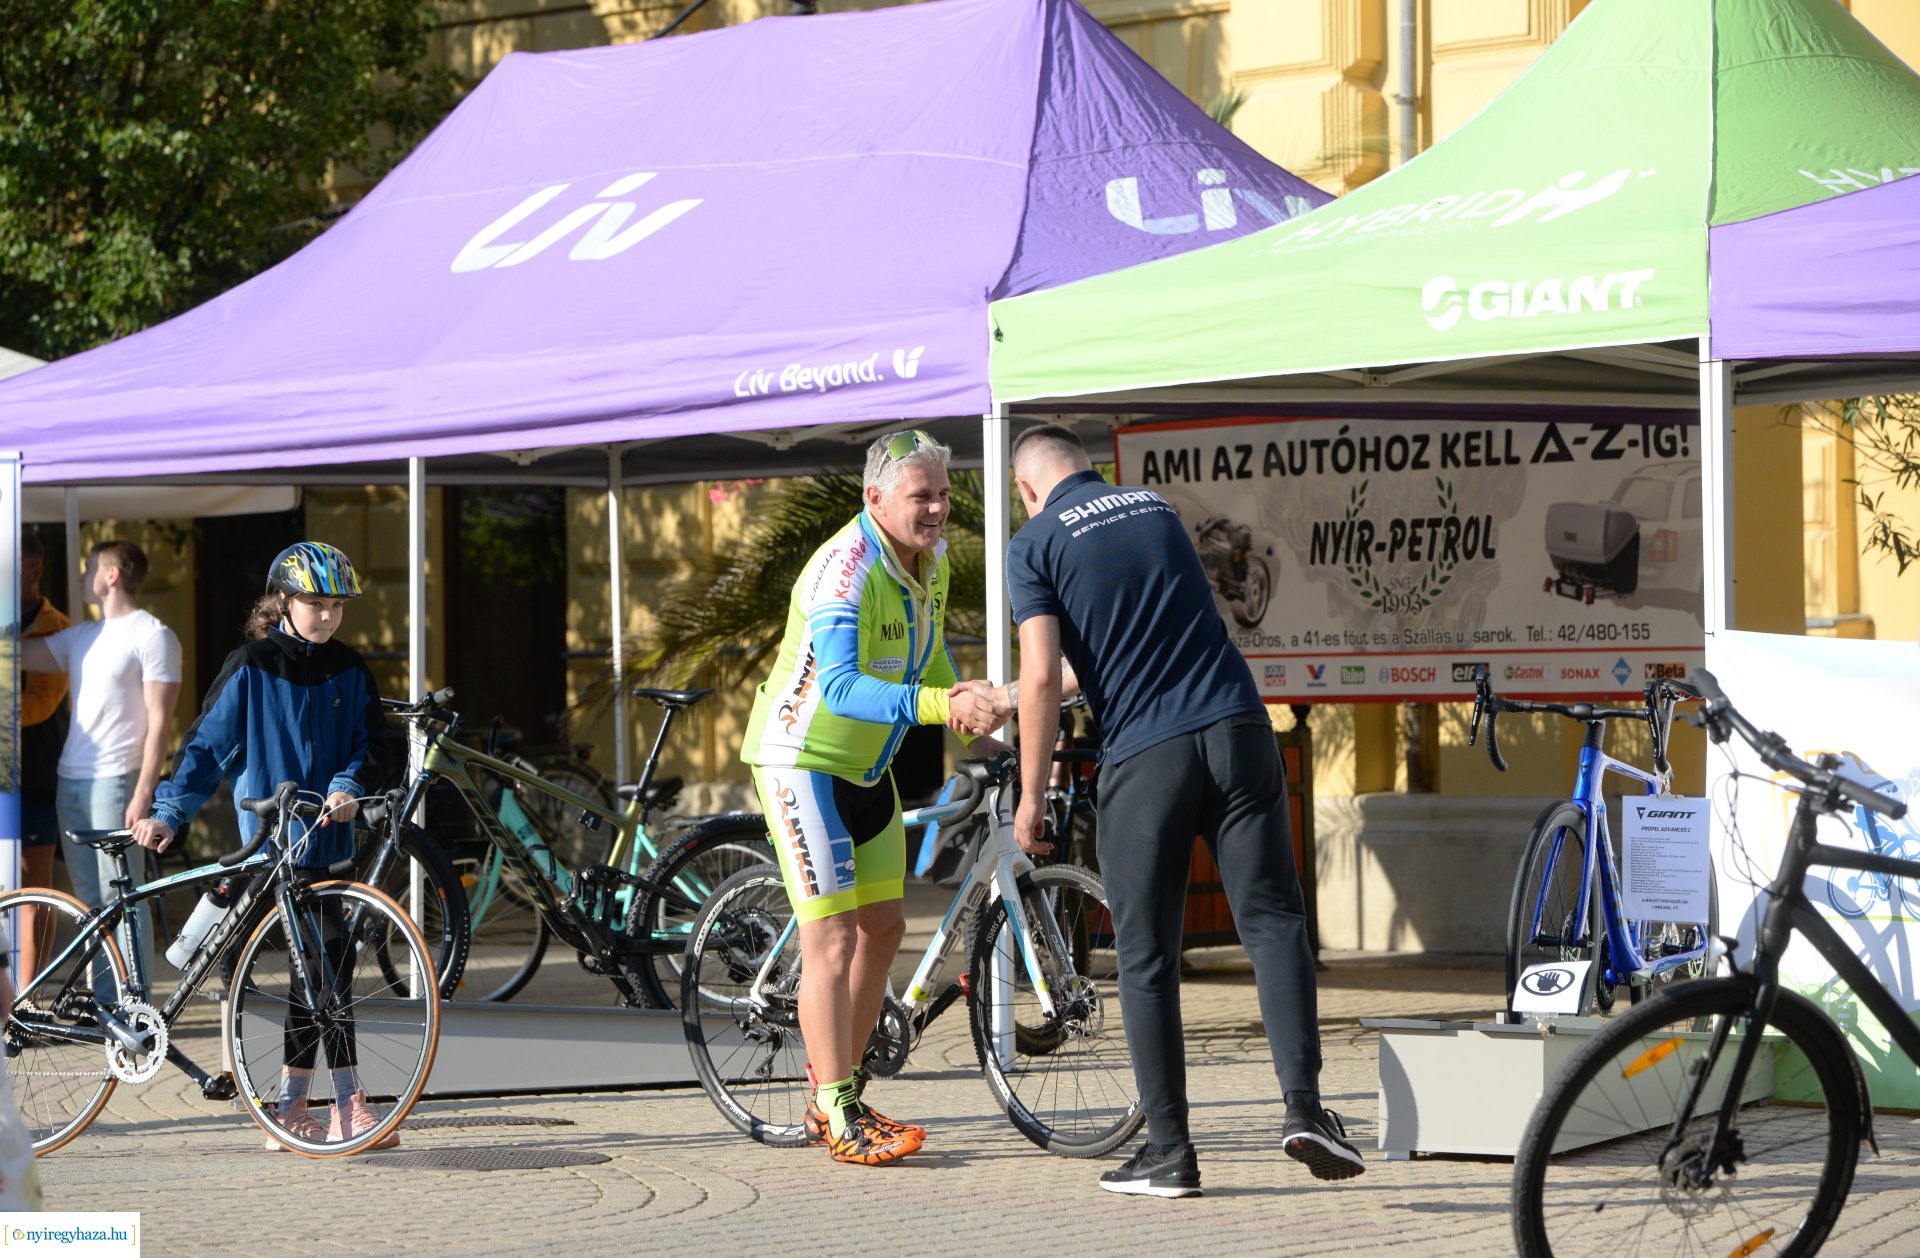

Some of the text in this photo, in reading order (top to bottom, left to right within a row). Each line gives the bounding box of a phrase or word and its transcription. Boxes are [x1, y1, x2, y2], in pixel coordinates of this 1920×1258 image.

[450, 172, 704, 273] Liv
[1273, 188, 1526, 246] HYBRID
[1467, 268, 1656, 321] GIANT
[734, 352, 884, 398] Liv Beyond.
[1142, 447, 1201, 486] AMI
[1211, 444, 1253, 482] AZ
[1263, 424, 1430, 478] AUTÓHOZ
[1440, 428, 1521, 469] KELL
[1071, 512, 1128, 539] SERVICE
[1310, 508, 1496, 567] NYÍR-PETROL
[1381, 594, 1423, 617] 1993
[1290, 634, 1299, 648] a
[1303, 630, 1340, 647] 41-es
[1392, 633, 1401, 646] a
[1403, 628, 1452, 646] Szállás
[1473, 626, 1517, 643] sarok.
[1526, 625, 1553, 643] Tel.:
[1557, 623, 1651, 644] 42/480-155
[1391, 666, 1436, 683] BOSCH
[1453, 665, 1476, 682] elf
[1512, 665, 1544, 680] Castrol
[1560, 667, 1600, 680] SONAX
[1657, 663, 1686, 679] Beta
[1646, 810, 1697, 819] GIANT
[784, 817, 820, 898] NYKSE
[279, 901, 306, 979] Bianchi
[985, 909, 1006, 945] DT SWISS
[163, 891, 251, 1017] Bianchi
